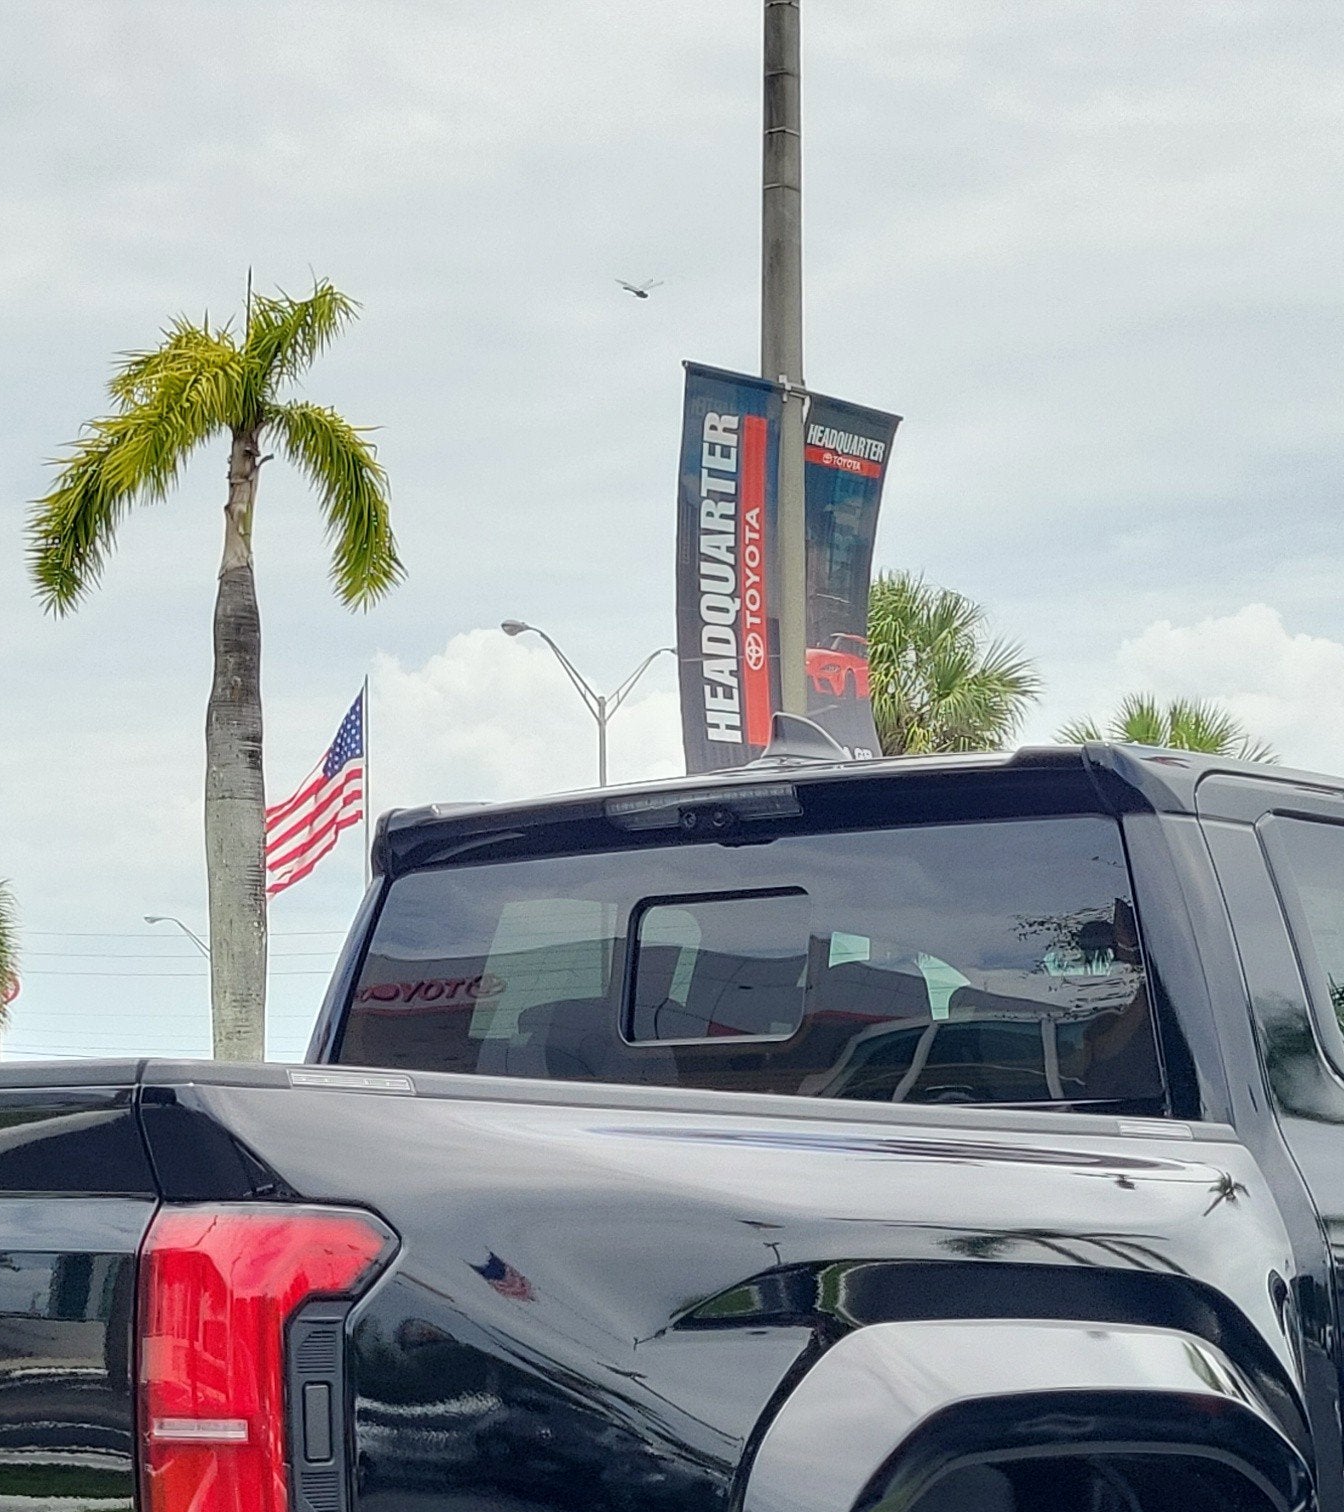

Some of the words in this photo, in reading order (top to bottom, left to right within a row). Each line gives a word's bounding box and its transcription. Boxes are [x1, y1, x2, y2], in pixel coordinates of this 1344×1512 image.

[806, 424, 886, 463] HEADQUARTER
[833, 456, 862, 471] TOYOTA
[699, 411, 743, 744] HEADQUARTER
[744, 507, 761, 629] TOYOTA
